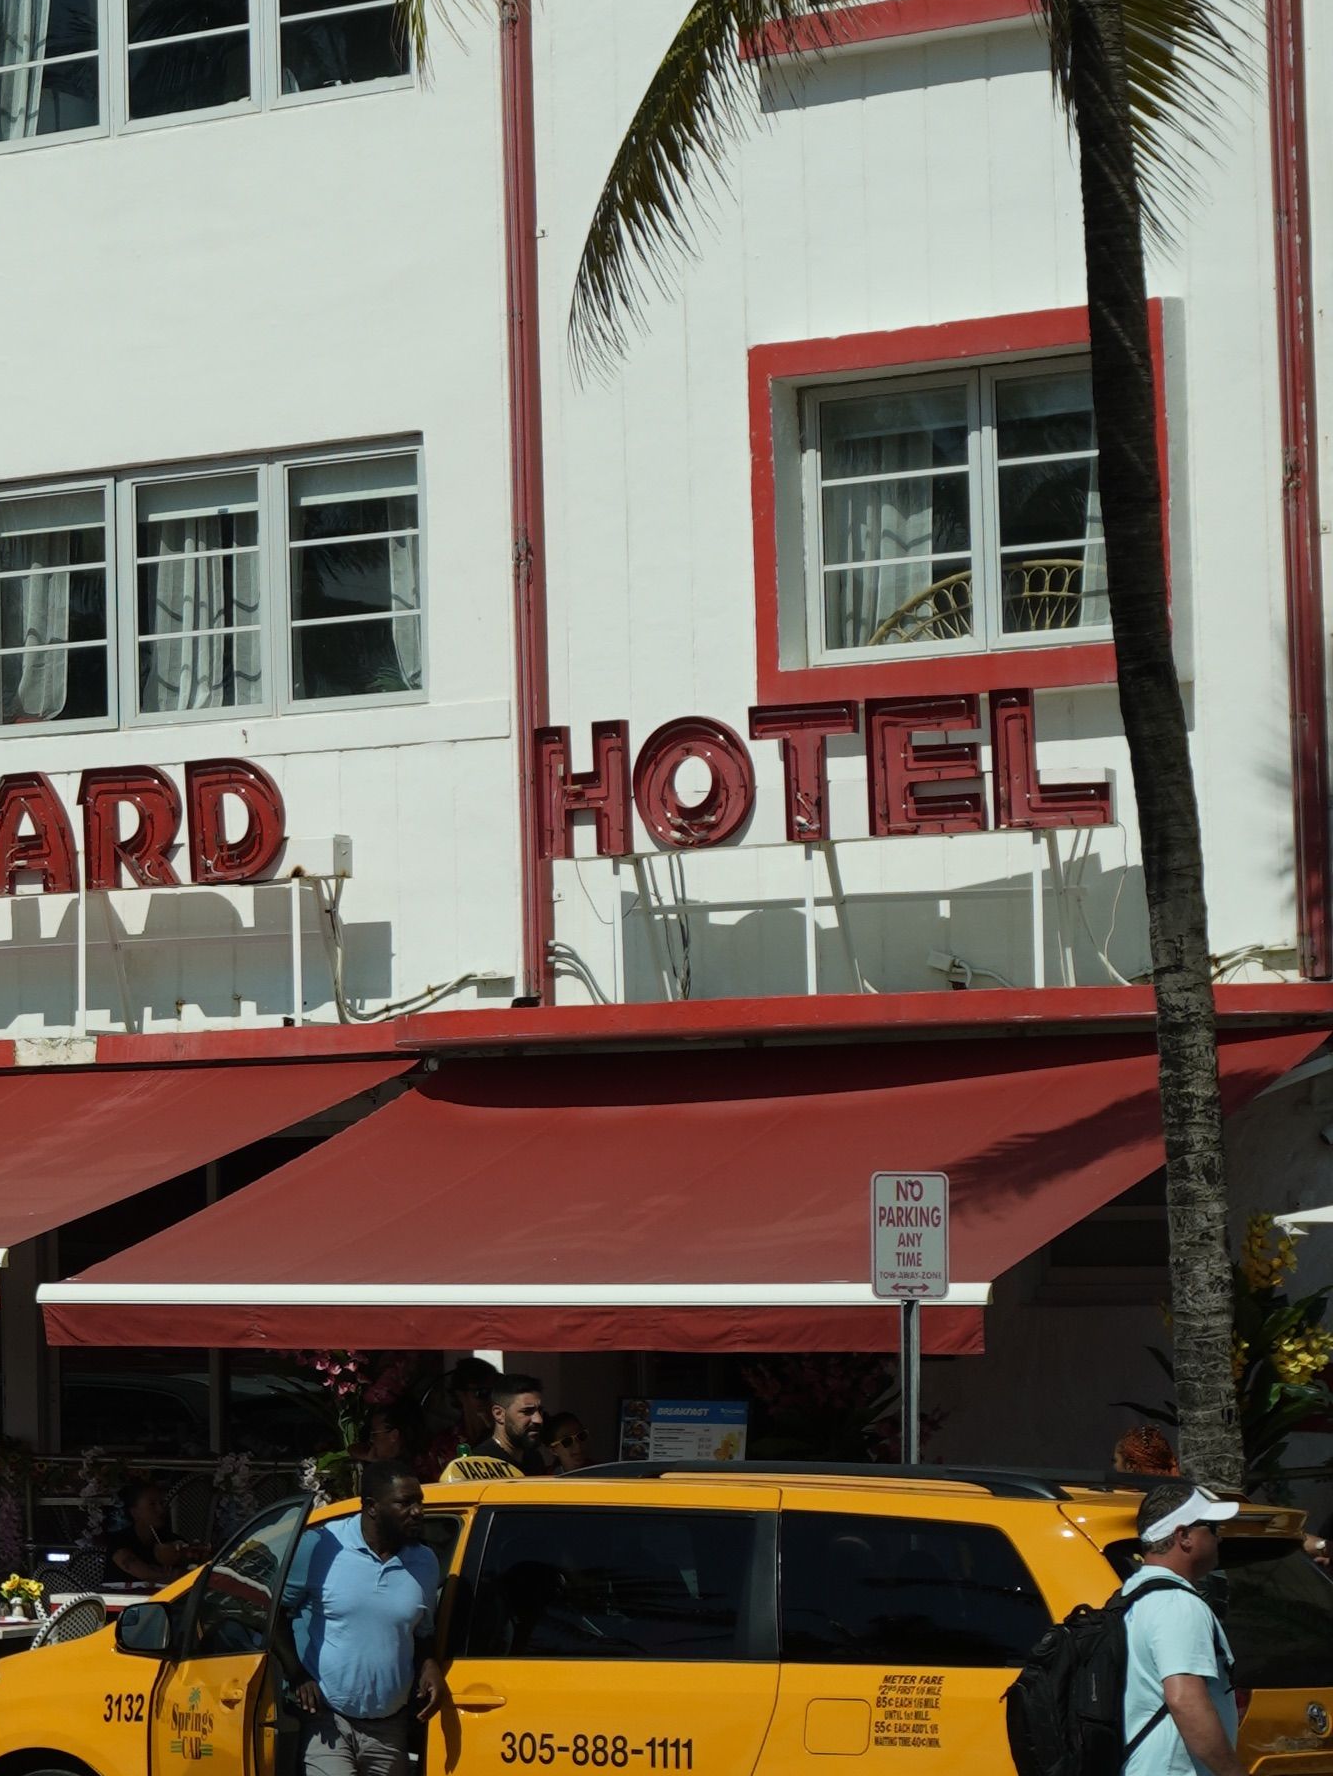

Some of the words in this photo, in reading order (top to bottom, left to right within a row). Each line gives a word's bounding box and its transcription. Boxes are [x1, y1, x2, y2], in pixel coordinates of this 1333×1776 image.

[535, 687, 1115, 859] HOTEL
[896, 1180, 923, 1202] NO
[878, 1206, 942, 1228] PARKING
[897, 1232, 923, 1247] ANY
[896, 1252, 923, 1267] TIME
[656, 1407, 710, 1416] BREAKFAST
[455, 1461, 515, 1480] VACANT
[882, 1675, 917, 1684] METER
[919, 1676, 945, 1685] FARE
[103, 1693, 145, 1722] 3132
[500, 1731, 693, 1769] 305-888-1111
